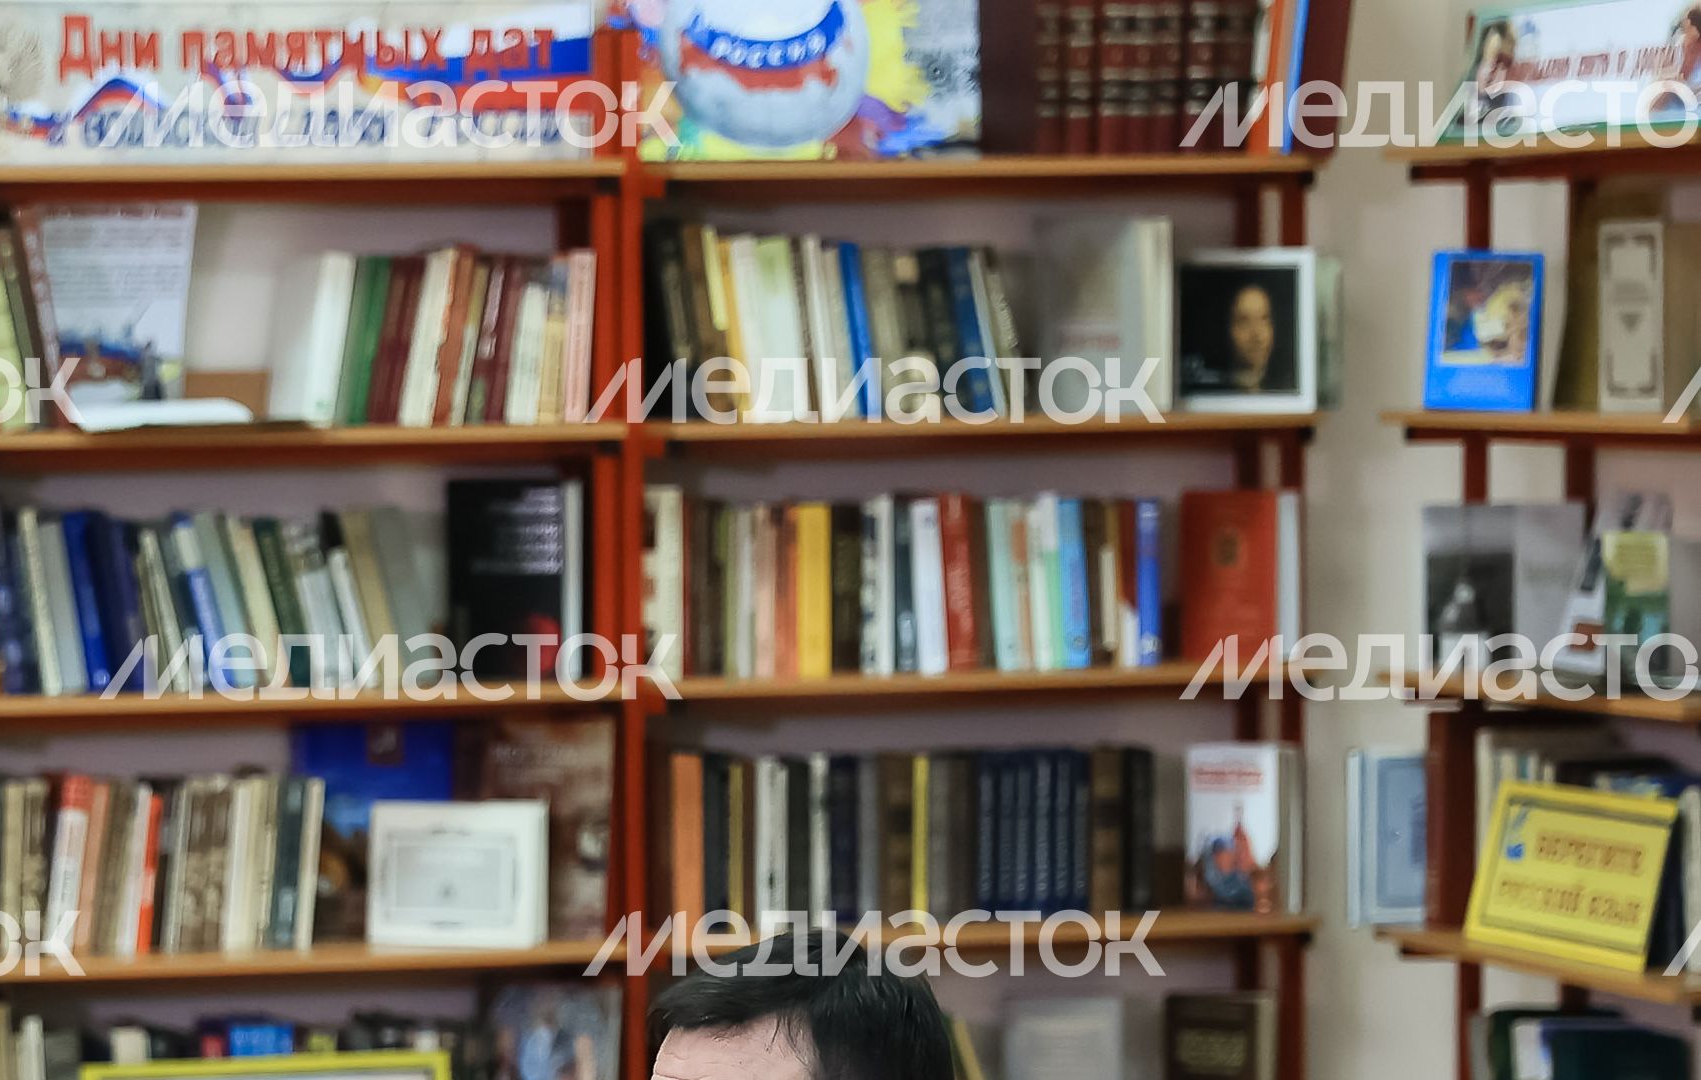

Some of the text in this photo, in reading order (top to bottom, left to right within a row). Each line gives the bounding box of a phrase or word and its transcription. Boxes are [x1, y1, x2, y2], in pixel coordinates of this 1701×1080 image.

[59, 15, 553, 84] Дни памятных дат
